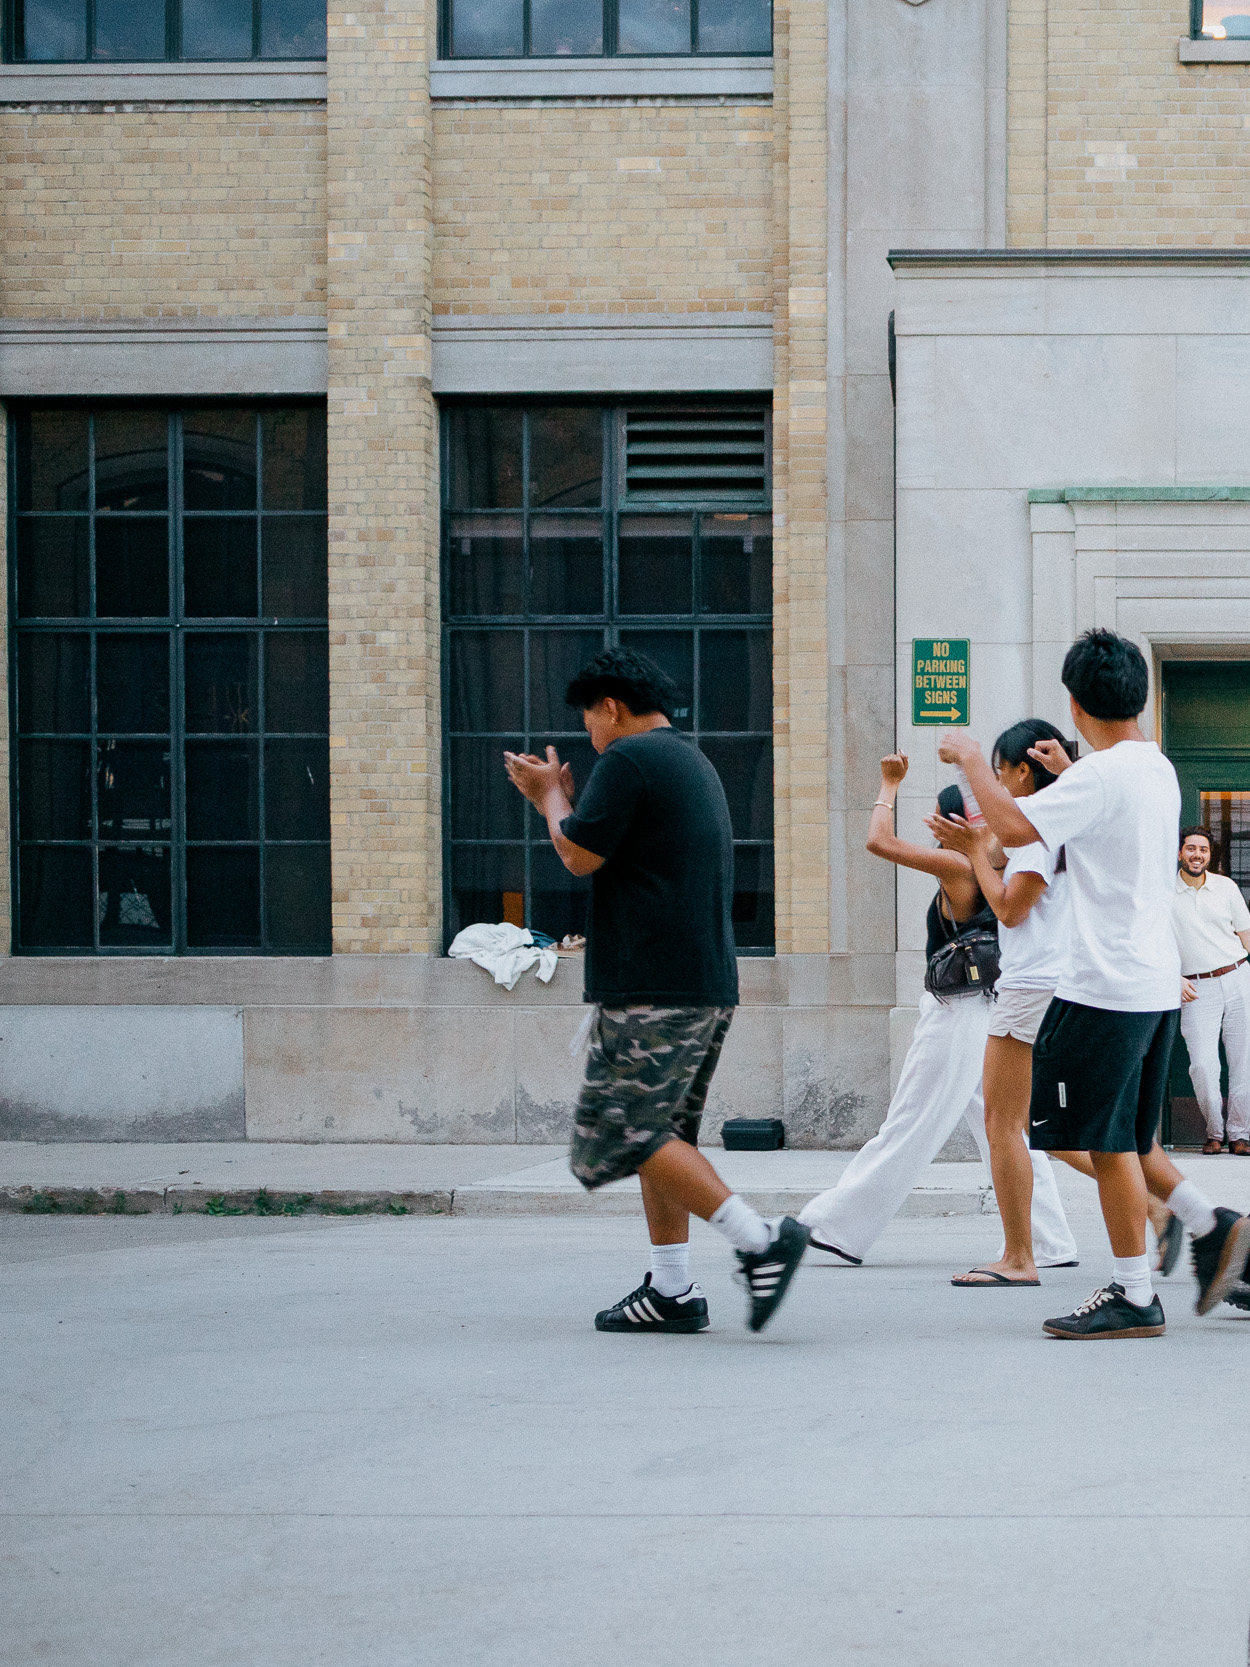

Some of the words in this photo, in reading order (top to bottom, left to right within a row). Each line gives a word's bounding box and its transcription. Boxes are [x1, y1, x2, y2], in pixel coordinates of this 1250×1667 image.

[933, 642, 949, 657] NO
[917, 660, 965, 673] PARKING
[916, 675, 966, 688] BETWEEN
[925, 691, 957, 704] SIGNS
